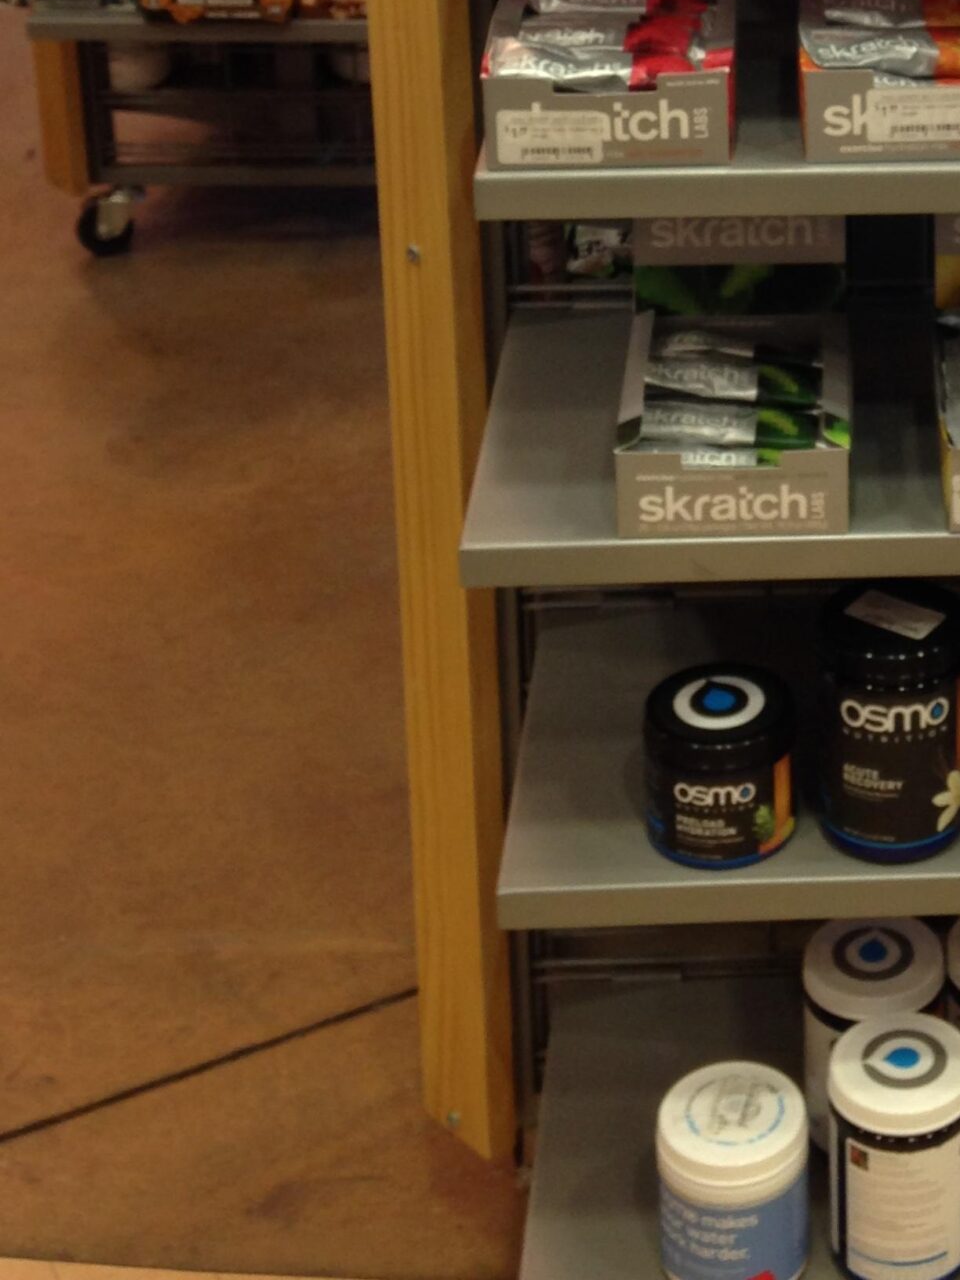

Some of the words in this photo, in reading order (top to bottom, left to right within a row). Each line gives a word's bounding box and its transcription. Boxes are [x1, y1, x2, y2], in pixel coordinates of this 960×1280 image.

[651, 216, 814, 249] skratch
[638, 484, 808, 522] skratch
[841, 697, 949, 733] osmo
[674, 782, 756, 807] osmo
